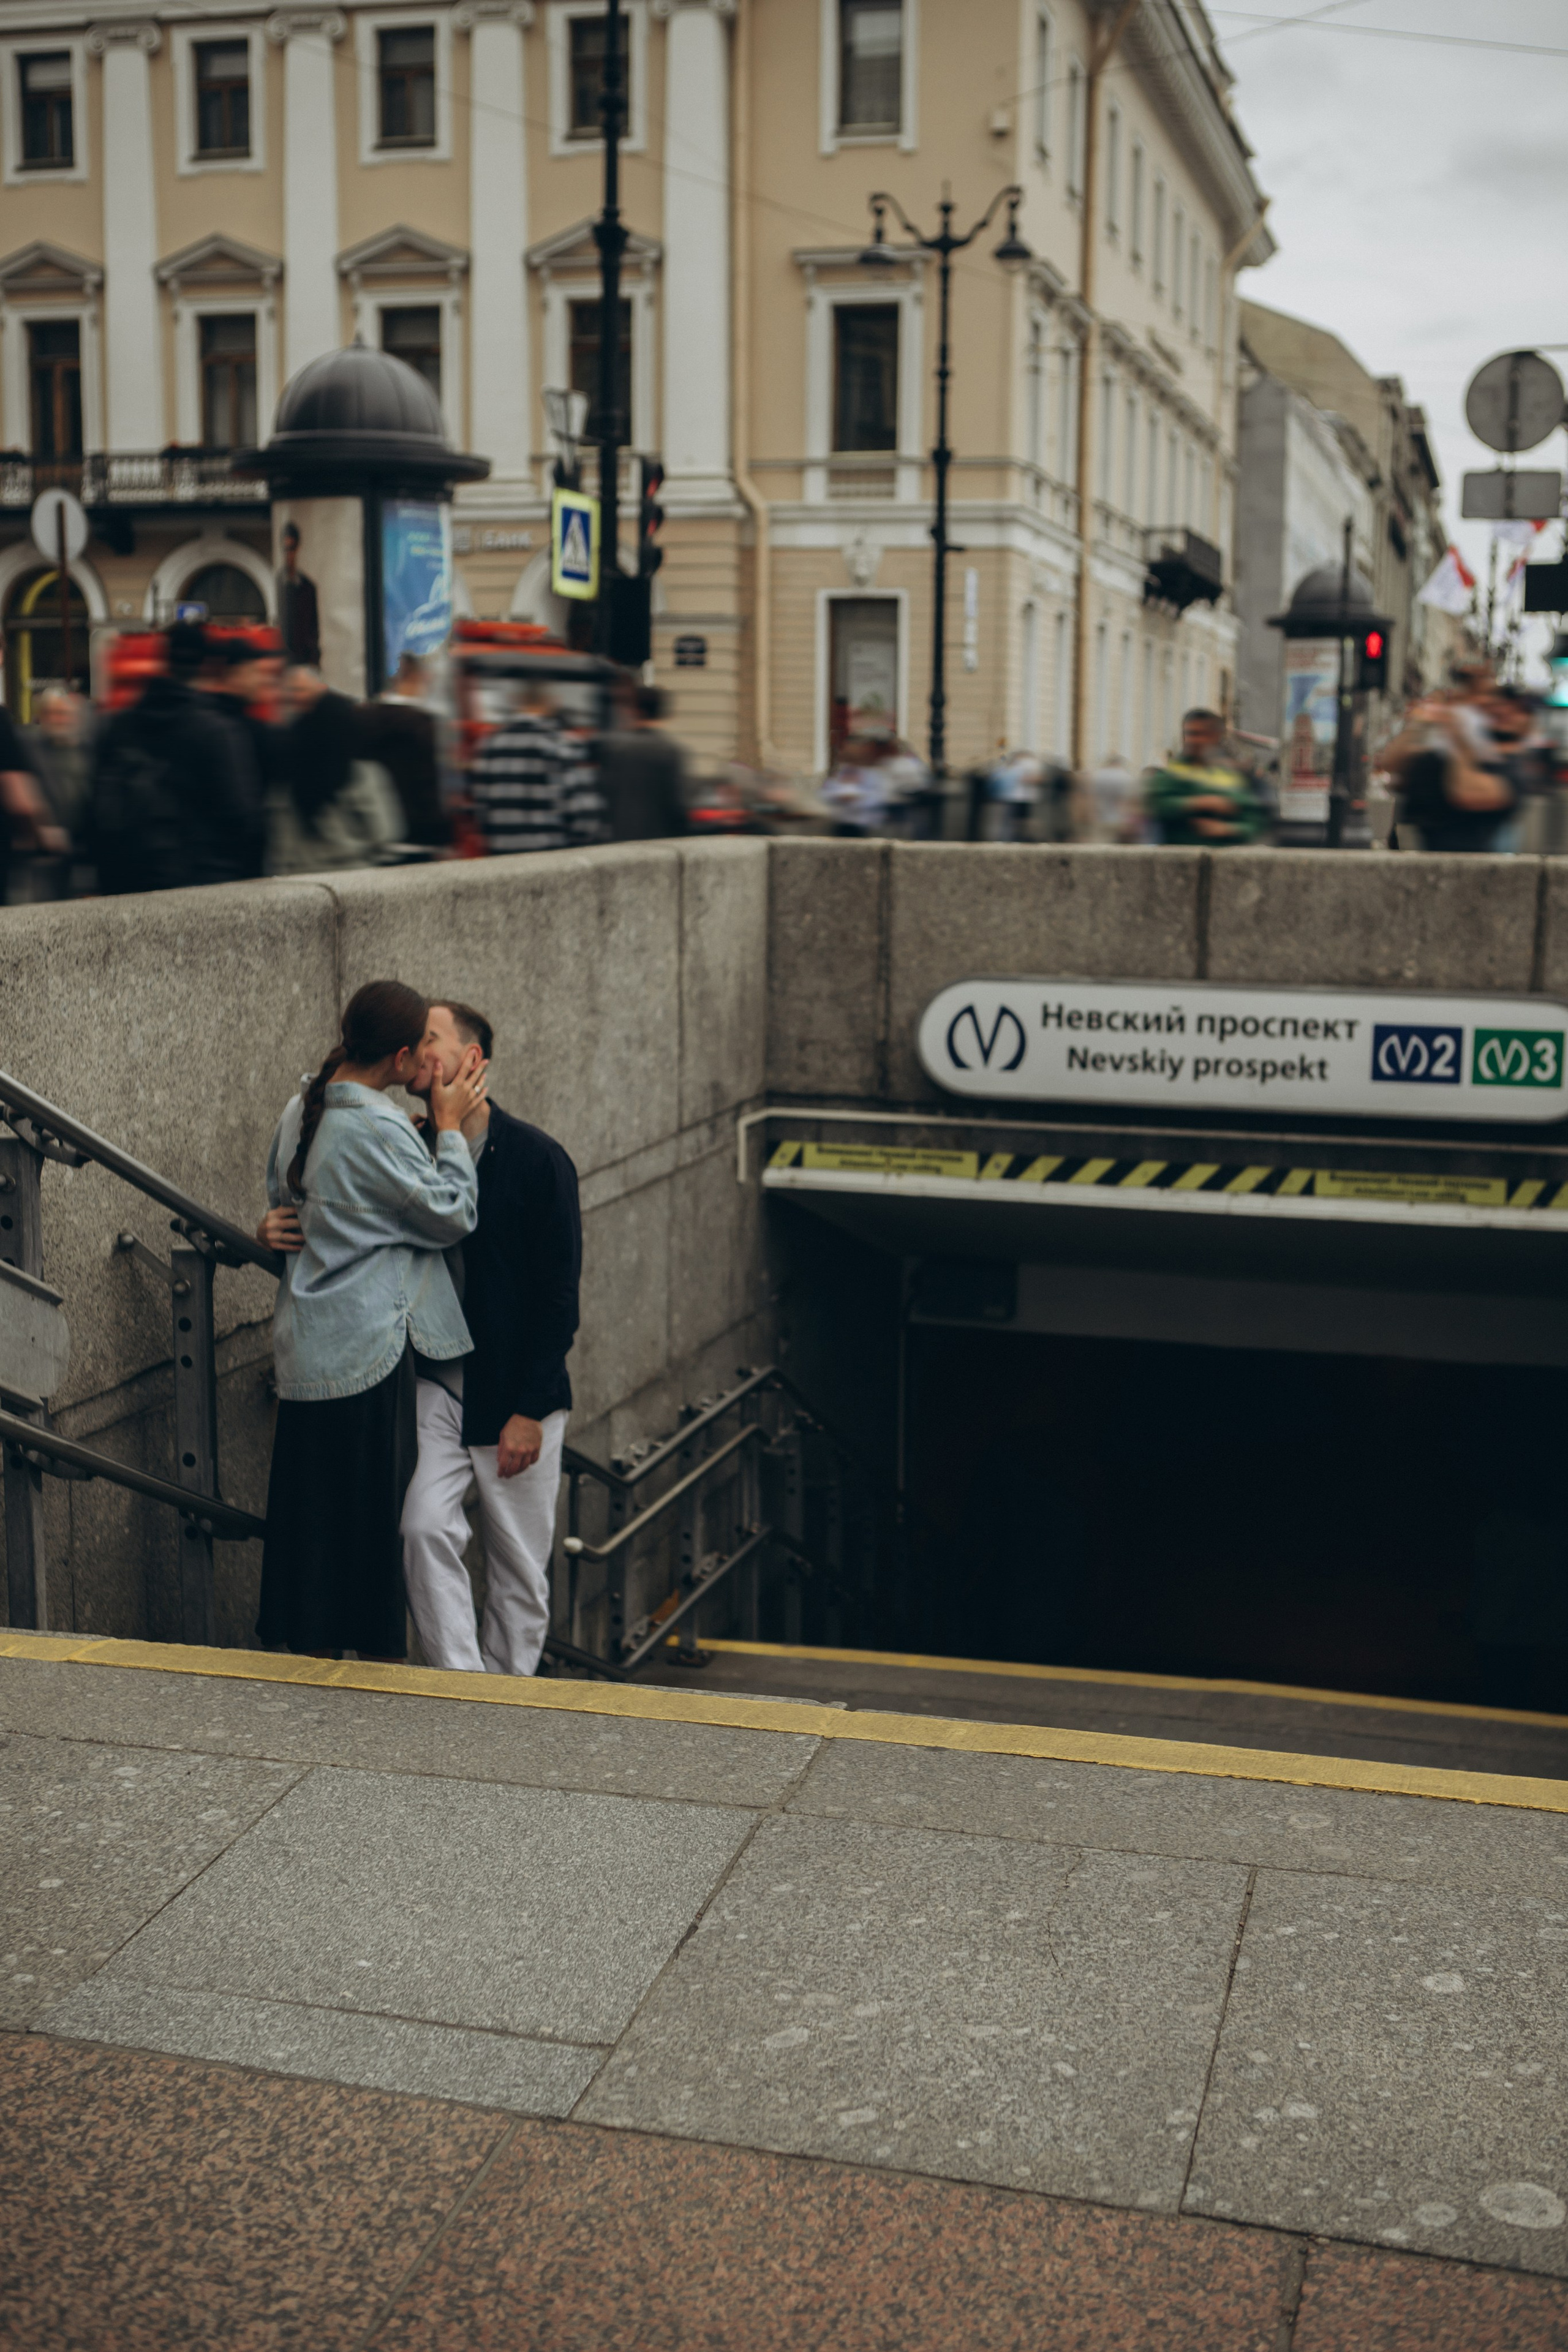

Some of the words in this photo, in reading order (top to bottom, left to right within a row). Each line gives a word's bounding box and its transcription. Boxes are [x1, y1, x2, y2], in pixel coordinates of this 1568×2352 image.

[1041, 1002, 1186, 1035] Невский
[1196, 1012, 1360, 1043] проспект
[1067, 1046, 1185, 1082] Nevskiy
[1193, 1054, 1329, 1085] prospekt
